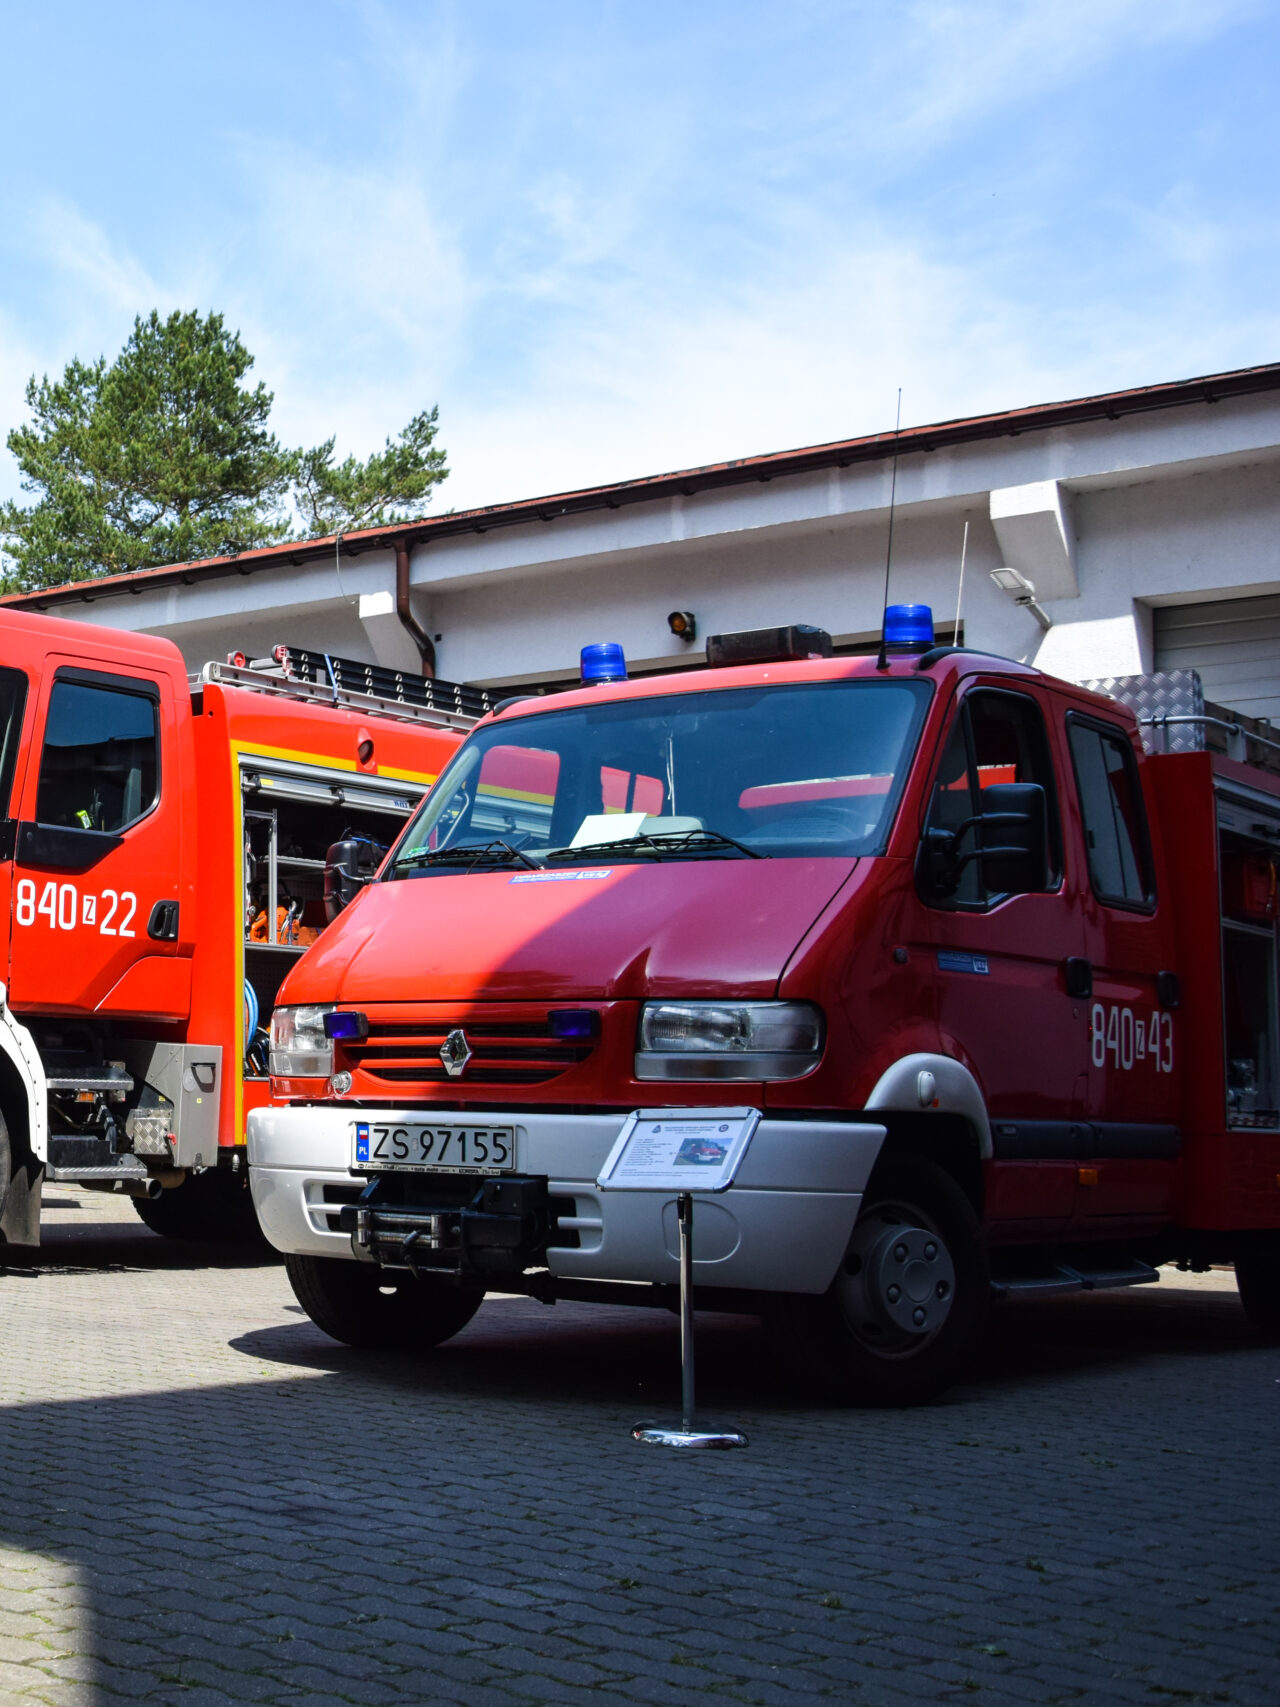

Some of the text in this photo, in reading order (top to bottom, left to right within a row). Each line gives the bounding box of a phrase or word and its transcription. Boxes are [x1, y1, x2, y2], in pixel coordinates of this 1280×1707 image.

[16, 879, 77, 931] 840
[100, 889, 137, 938] 22
[1092, 1003, 1133, 1071] 840
[1148, 1010, 1173, 1073] 43
[359, 1128, 508, 1164] PL ZS 97155
